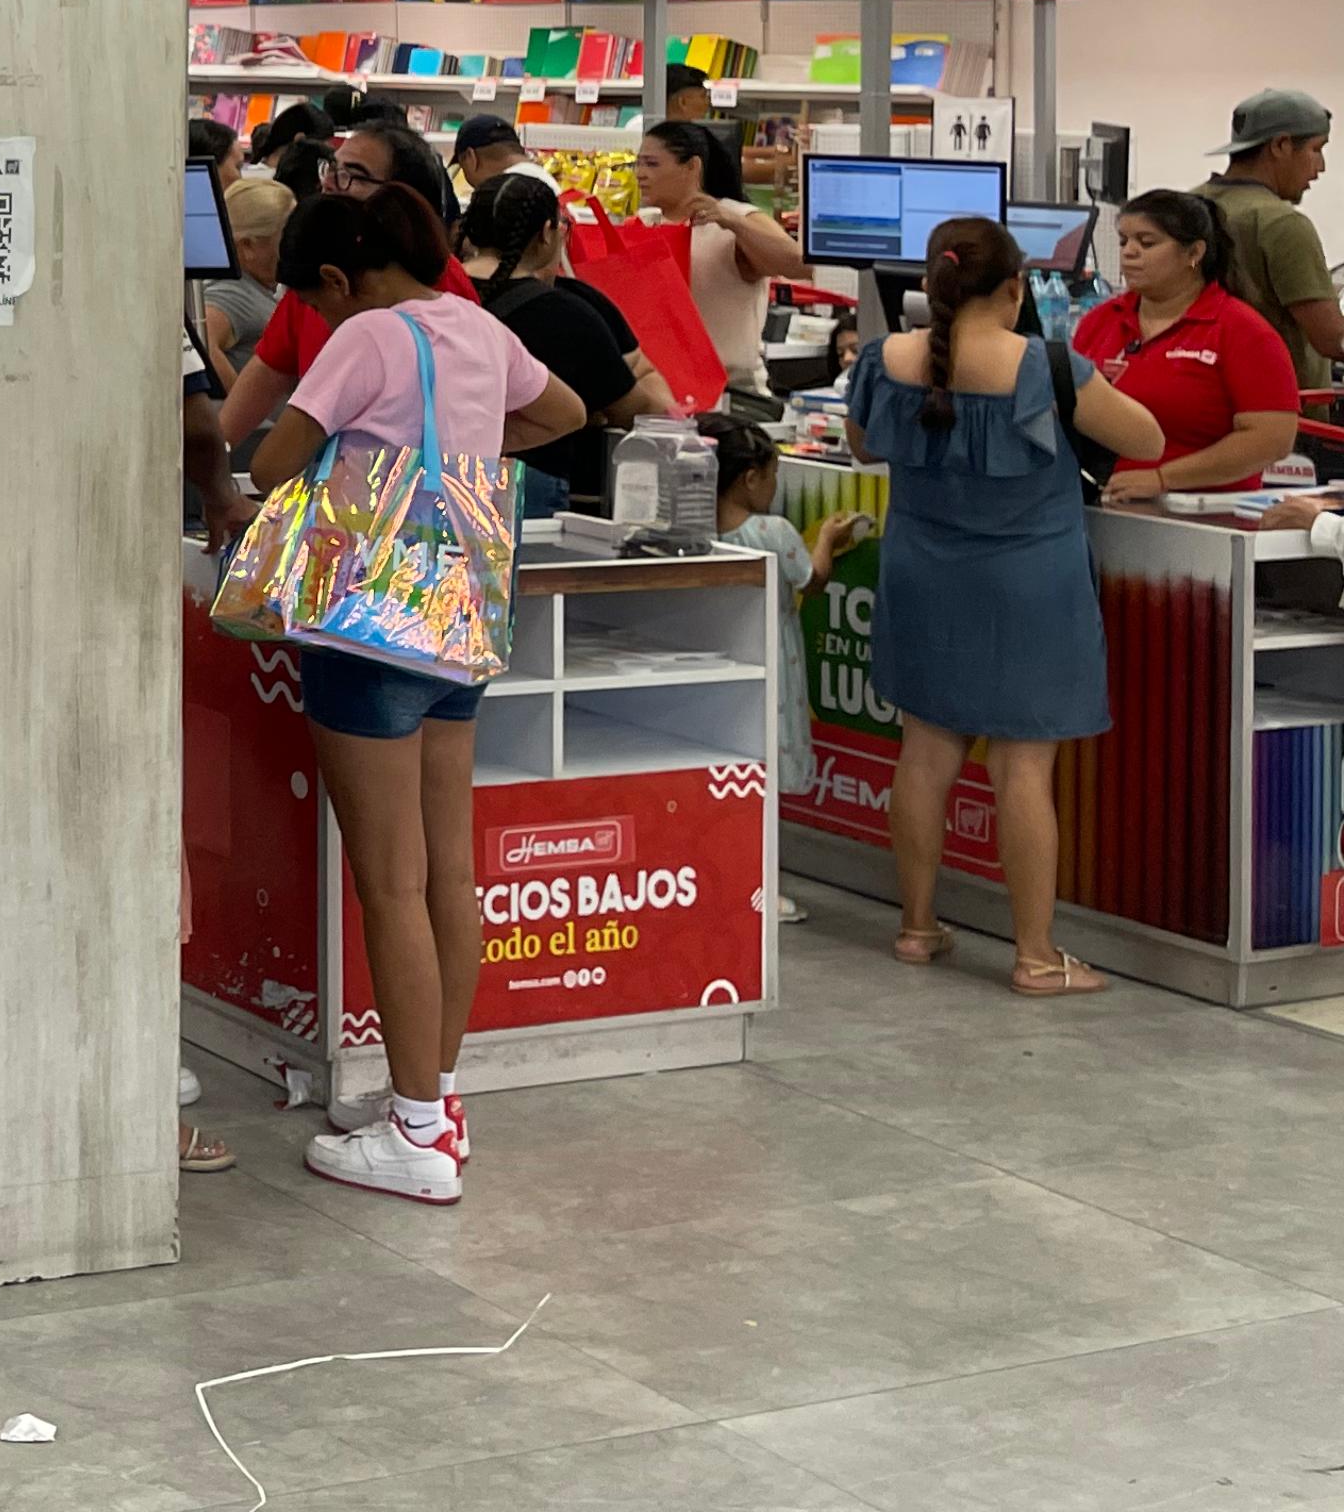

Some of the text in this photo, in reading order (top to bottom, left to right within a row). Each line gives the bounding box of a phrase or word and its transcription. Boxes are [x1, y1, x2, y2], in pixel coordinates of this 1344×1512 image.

[825, 633, 850, 657] EN
[505, 833, 596, 864] HEMSA
[577, 866, 697, 917] BAJOS
[549, 921, 576, 956] el
[585, 919, 639, 953] año
